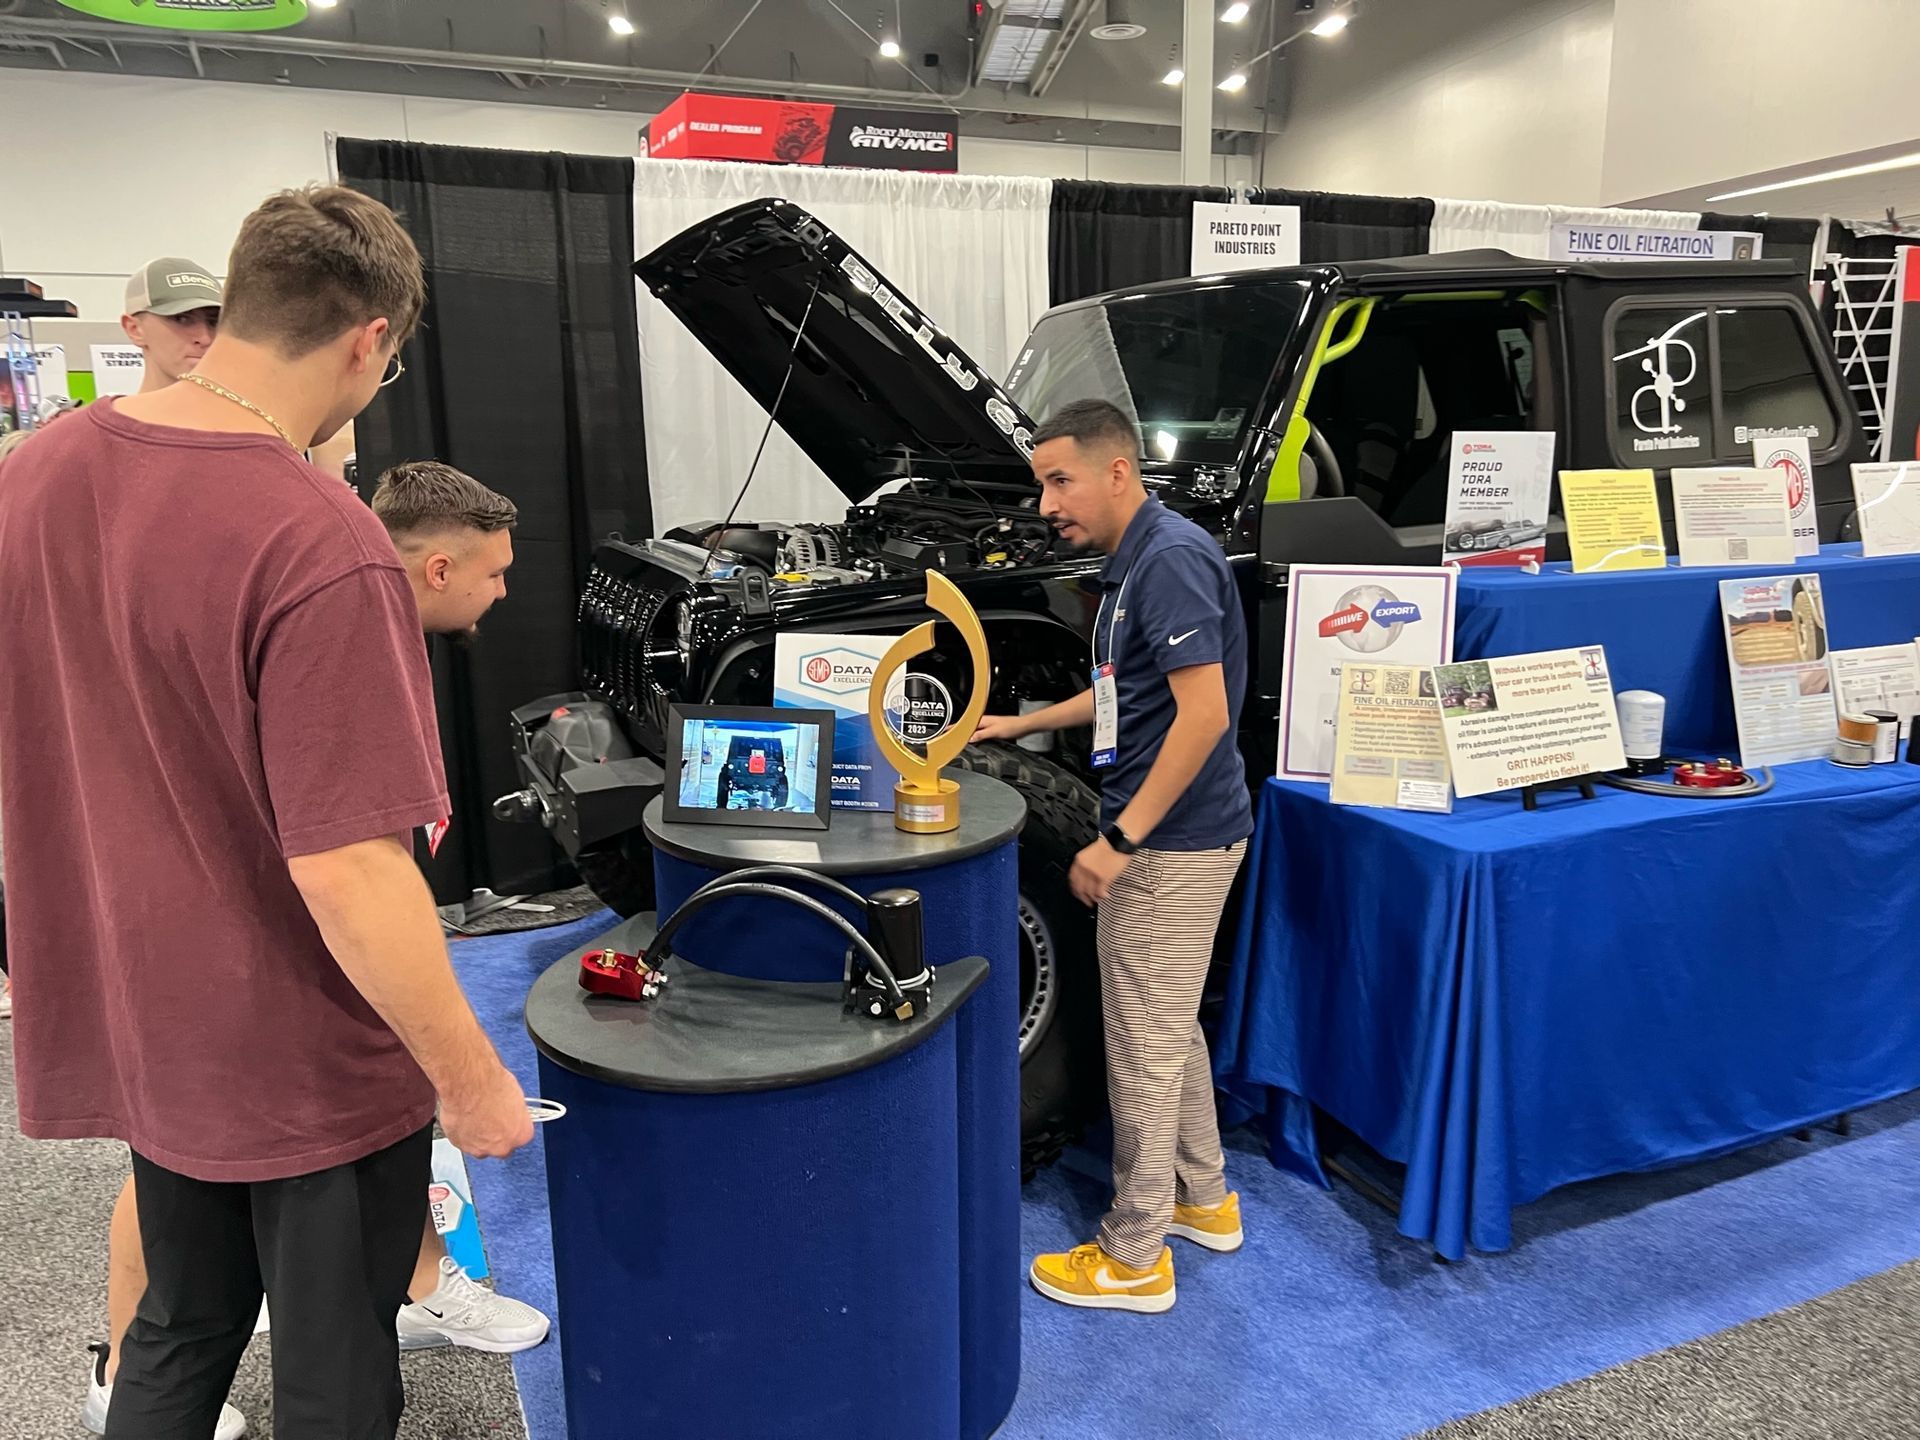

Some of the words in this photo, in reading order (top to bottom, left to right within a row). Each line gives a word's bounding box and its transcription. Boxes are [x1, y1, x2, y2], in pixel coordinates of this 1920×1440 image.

[690, 121, 720, 132] DEALER
[721, 124, 762, 134] PROGRAM
[866, 126, 897, 137] ROCKY
[897, 128, 948, 140] MOUNTAIN
[1210, 222, 1248, 236] PARETO
[1251, 223, 1281, 236] POINT
[1215, 241, 1276, 255] INDUSTRIES
[1569, 231, 1602, 250] FINE
[1607, 233, 1631, 252] OIL
[1636, 235, 1713, 255] FILTRATION
[1462, 462, 1503, 472] PROUD
[1462, 475, 1492, 484] TORA
[1459, 487, 1509, 497] MEMBER
[1375, 606, 1416, 617] EXPORT
[833, 665, 873, 675] DATA
[1495, 666, 1520, 675] Without
[1527, 663, 1553, 671] working
[1554, 660, 1577, 668] engine,
[1496, 680, 1510, 689] your
[1558, 671, 1582, 679] nothing
[1546, 685, 1560, 694] yard
[912, 701, 945, 709] DATA
[1354, 696, 1372, 704] FINE
[1375, 697, 1389, 705] OIL
[912, 710, 945, 718] EXCELLENCE
[1461, 718, 1486, 726] Abrasive
[1564, 705, 1576, 713] your
[1570, 715, 1582, 723] your
[907, 725, 927, 734] 2023
[1473, 738, 1501, 748] advanced
[1535, 731, 1557, 740] systems
[1559, 727, 1579, 736] protect
[1470, 751, 1499, 760] extending
[1500, 746, 1525, 755] longevity
[1542, 740, 1571, 748] optimizing
[1507, 759, 1528, 771] GRIT
[1530, 751, 1575, 767] HAPPENS!
[831, 776, 860, 784] DATA
[1497, 777, 1509, 787] Be
[1510, 770, 1550, 786] prepared
[1551, 769, 1559, 777] to
[1561, 765, 1579, 775] fight
[1581, 763, 1590, 772] it!
[432, 1203, 446, 1229] DATA
